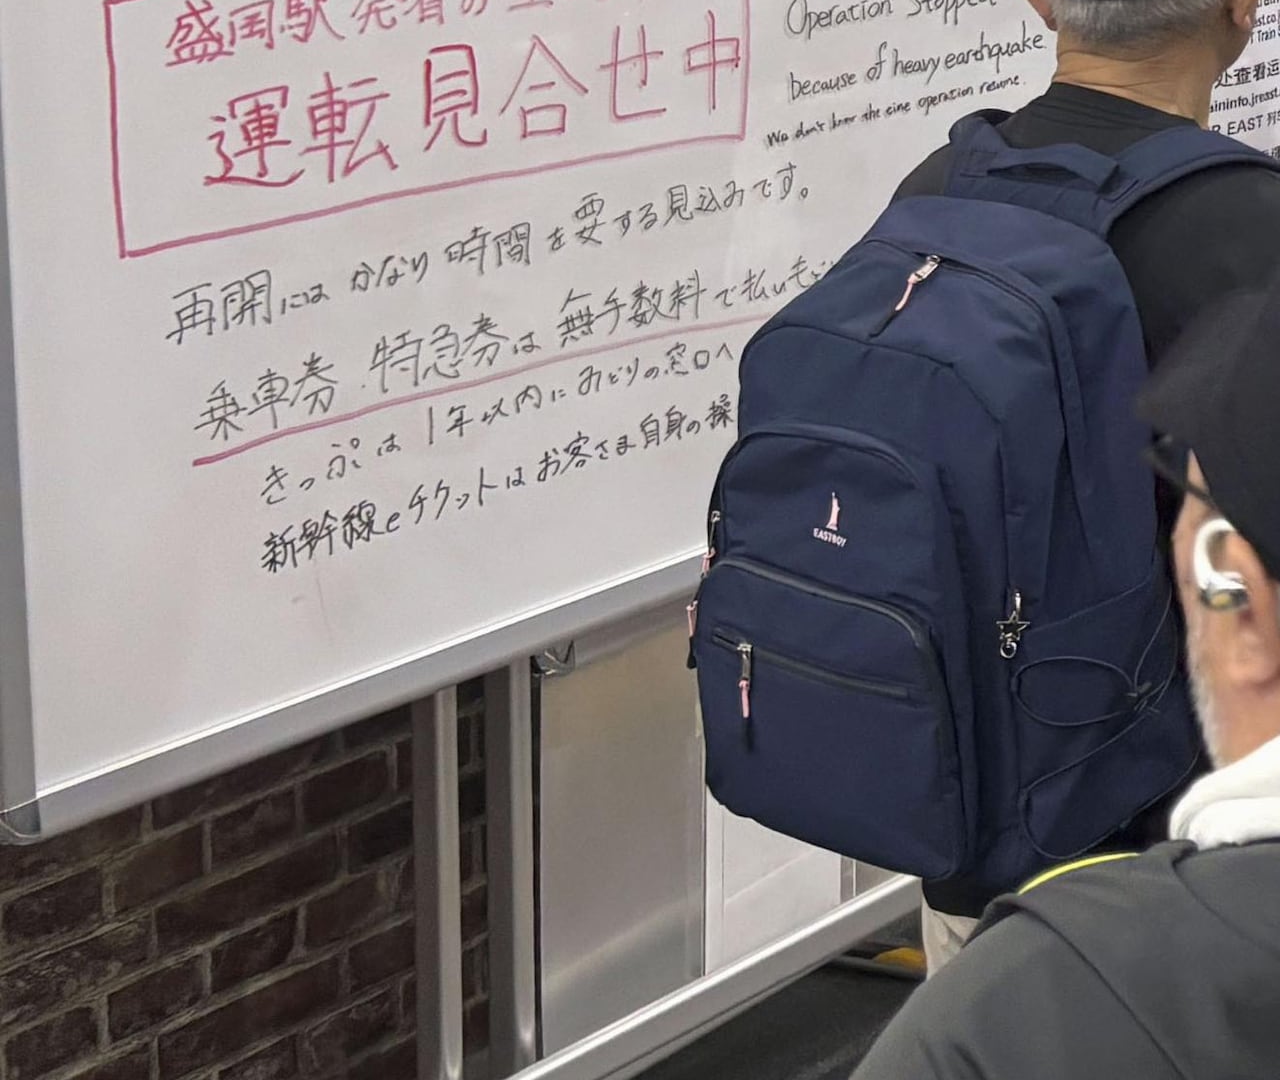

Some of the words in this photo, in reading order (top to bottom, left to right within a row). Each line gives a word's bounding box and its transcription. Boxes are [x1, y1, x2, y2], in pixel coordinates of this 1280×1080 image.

[790, 71, 857, 101] because
[867, 41, 887, 80] of
[892, 49, 941, 85] heavy
[202, 10, 742, 188] 運転見合せ中
[918, 86, 974, 116] operation
[1227, 115, 1263, 136] EAST
[813, 527, 847, 548] EASTBOY
